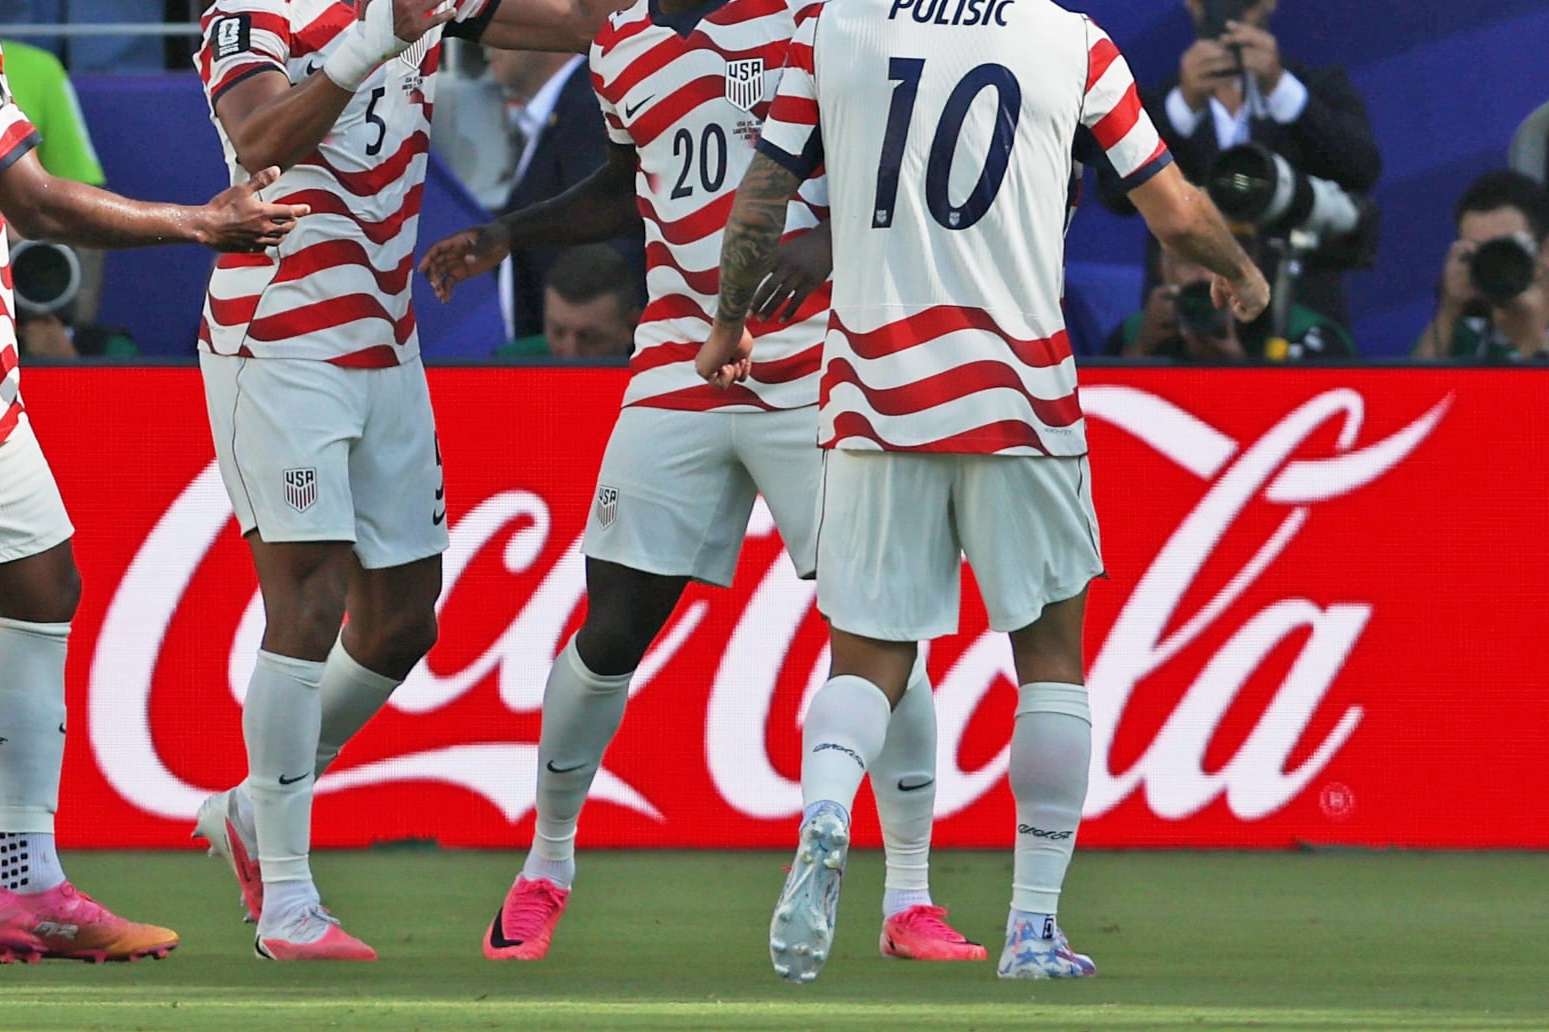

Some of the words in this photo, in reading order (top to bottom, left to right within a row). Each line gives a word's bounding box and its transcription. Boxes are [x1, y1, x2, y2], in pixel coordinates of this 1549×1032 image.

[728, 60, 761, 81] USA
[365, 86, 386, 156] 5
[871, 57, 1022, 230] 10
[670, 122, 728, 200] 20
[285, 470, 314, 487] USA
[599, 488, 617, 505] USA
[88, 384, 1456, 824] Cca-Cola
